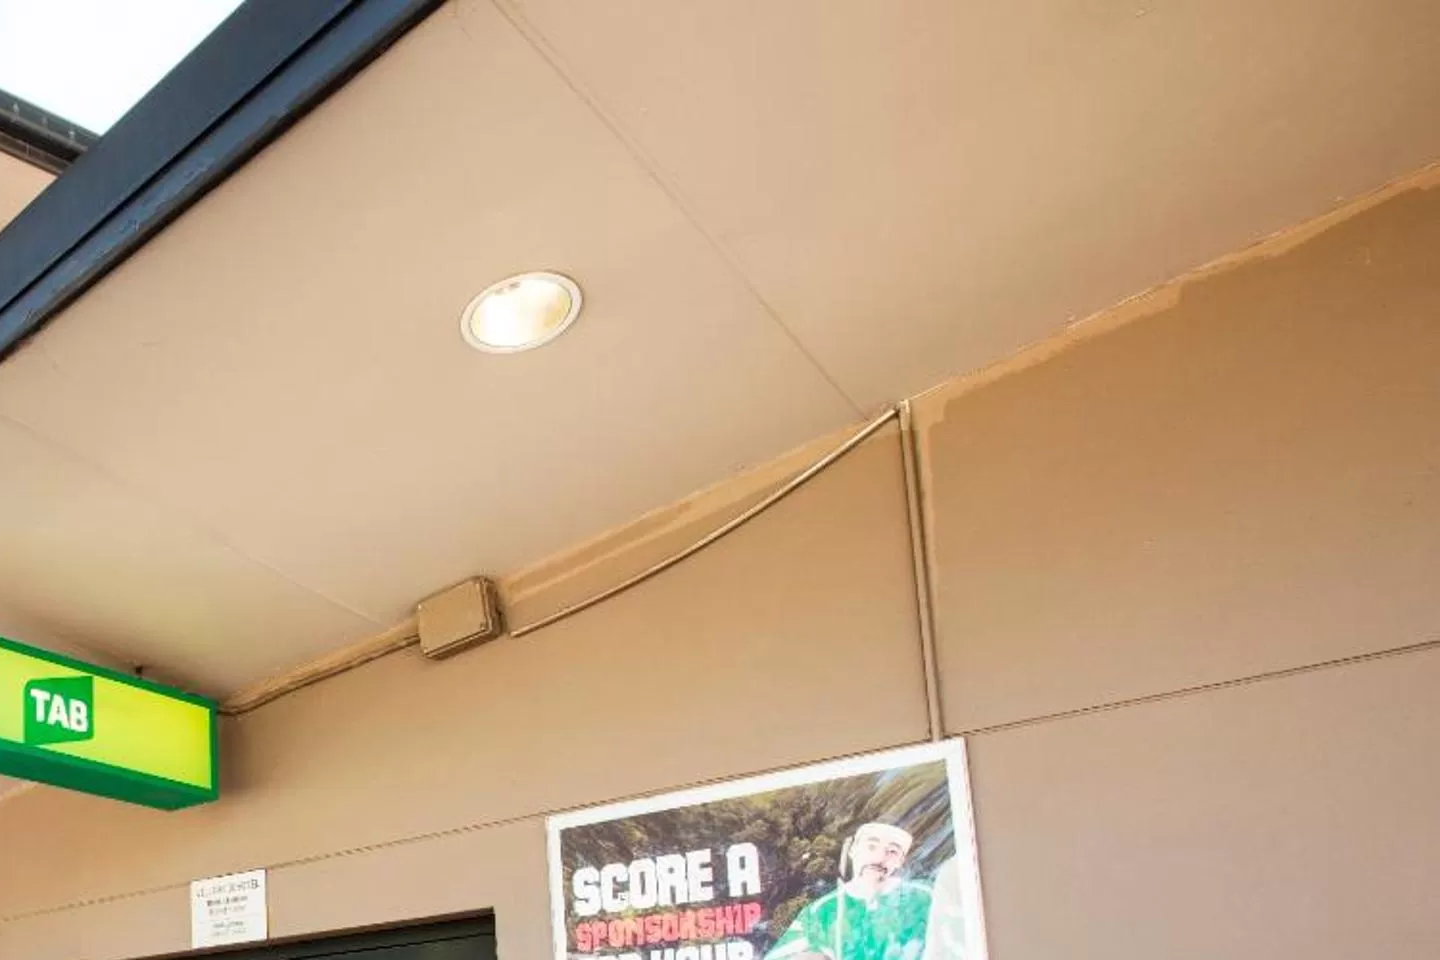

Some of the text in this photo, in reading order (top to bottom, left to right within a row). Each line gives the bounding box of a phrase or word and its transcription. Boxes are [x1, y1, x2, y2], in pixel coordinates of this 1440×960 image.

[30, 688, 88, 732] TAB
[572, 842, 762, 916] SCORE A
[575, 903, 764, 952] SPONSORSHIP
